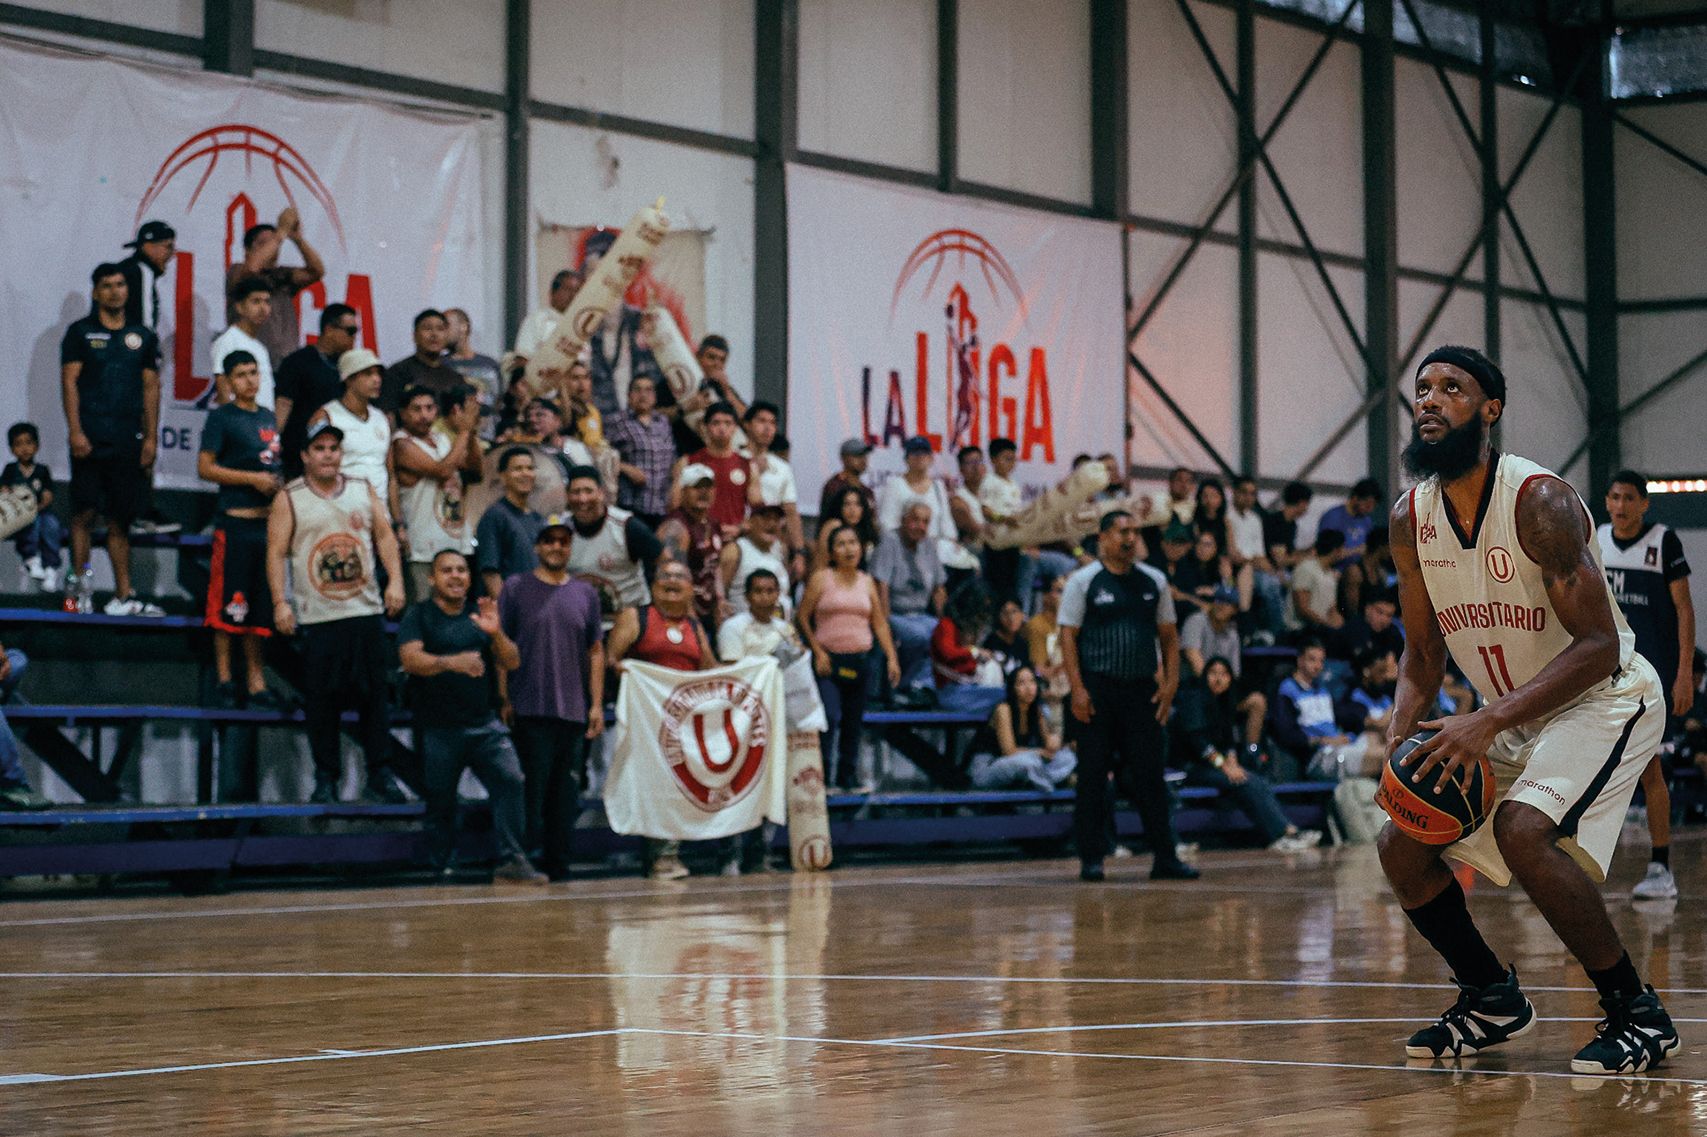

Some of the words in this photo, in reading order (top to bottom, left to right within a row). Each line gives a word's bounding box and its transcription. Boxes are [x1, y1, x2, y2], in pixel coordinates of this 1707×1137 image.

[862, 366, 908, 447] LA
[916, 282, 1055, 463] LIGA
[162, 428, 192, 450] DE
[1490, 553, 1509, 580] U
[1477, 644, 1515, 697] 11
[693, 708, 740, 773] U
[1520, 778, 1566, 806] marathon
